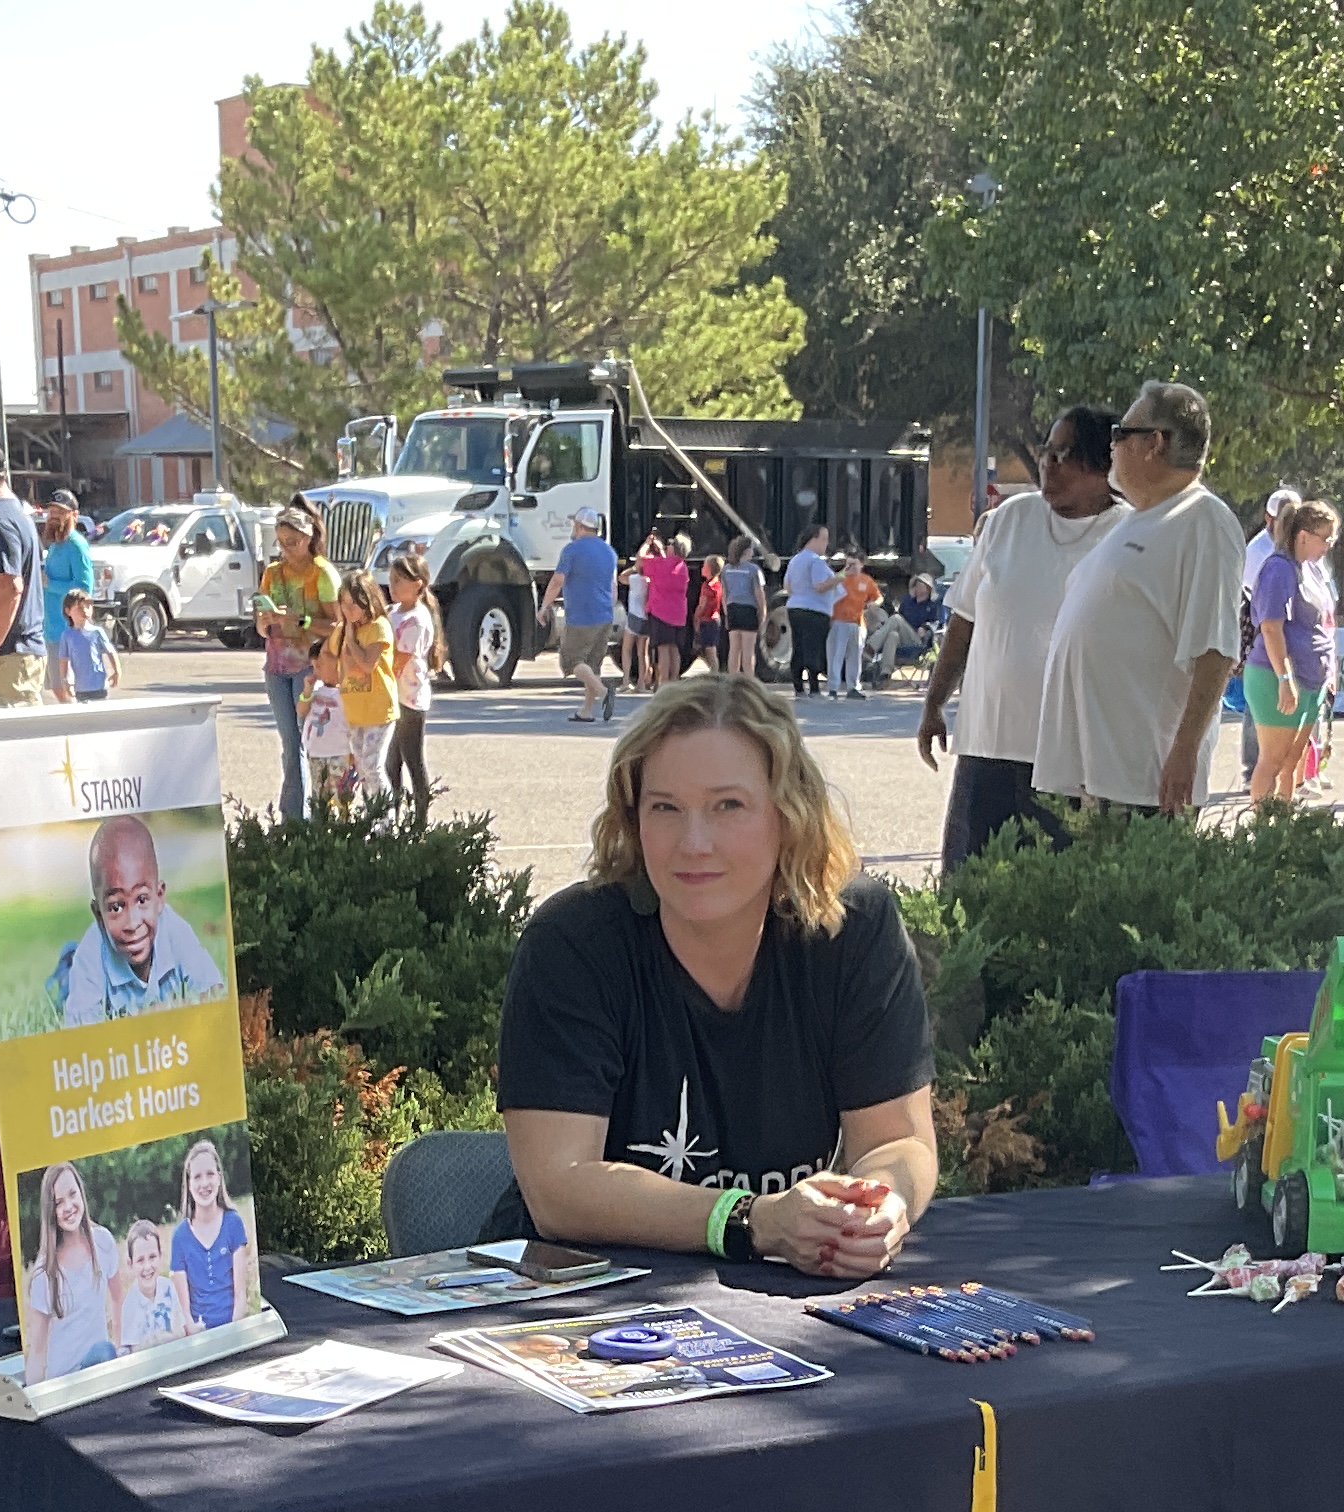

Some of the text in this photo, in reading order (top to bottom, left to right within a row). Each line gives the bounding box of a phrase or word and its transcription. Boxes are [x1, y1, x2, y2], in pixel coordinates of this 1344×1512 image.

[80, 775, 142, 813] STARRY
[53, 1034, 189, 1092] Help in Life's
[50, 1081, 200, 1138] Darkest Hours
